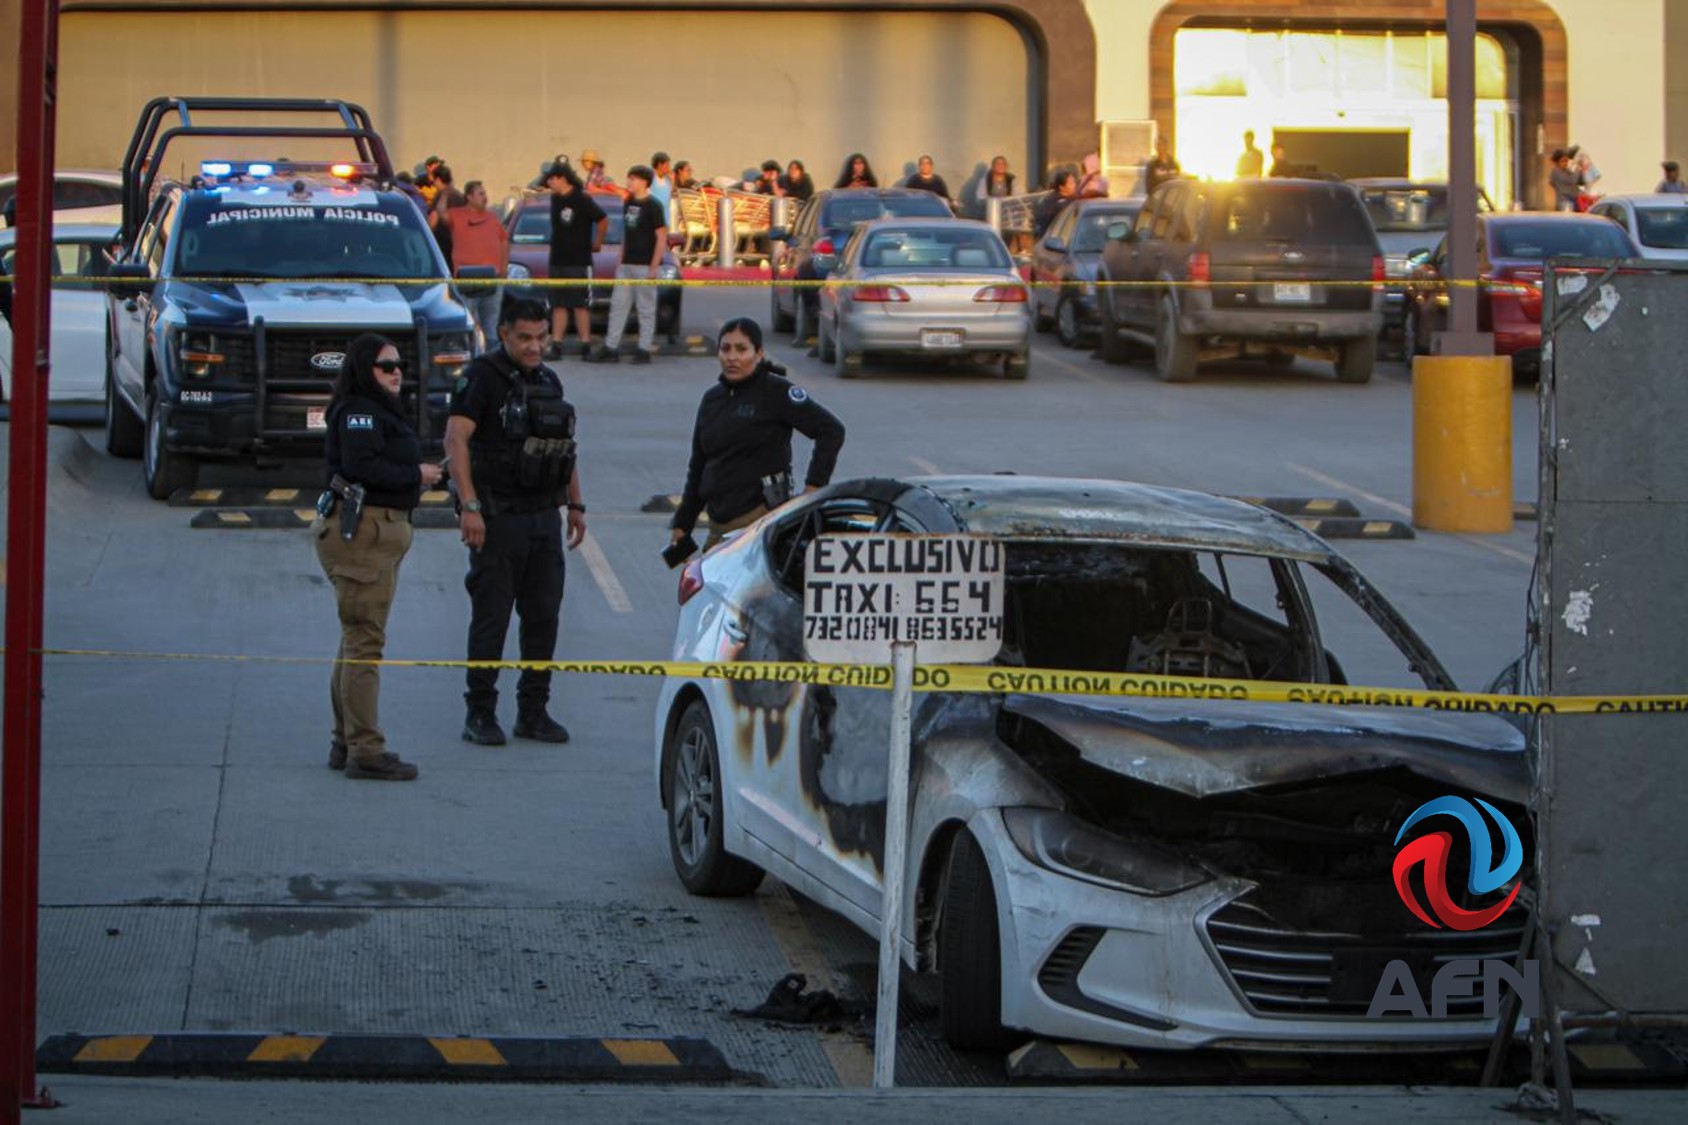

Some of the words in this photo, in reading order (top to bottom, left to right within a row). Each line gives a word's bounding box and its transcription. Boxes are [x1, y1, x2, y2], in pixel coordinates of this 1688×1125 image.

[315, 354, 345, 367] Ford
[350, 417, 371, 425] AEI
[814, 538, 1000, 573] EXCLUSIVO
[807, 581, 900, 613] TAXI:
[805, 616, 898, 640] 7320841
[906, 616, 1002, 640] 8635524
[1593, 700, 1688, 712] CAUTI
